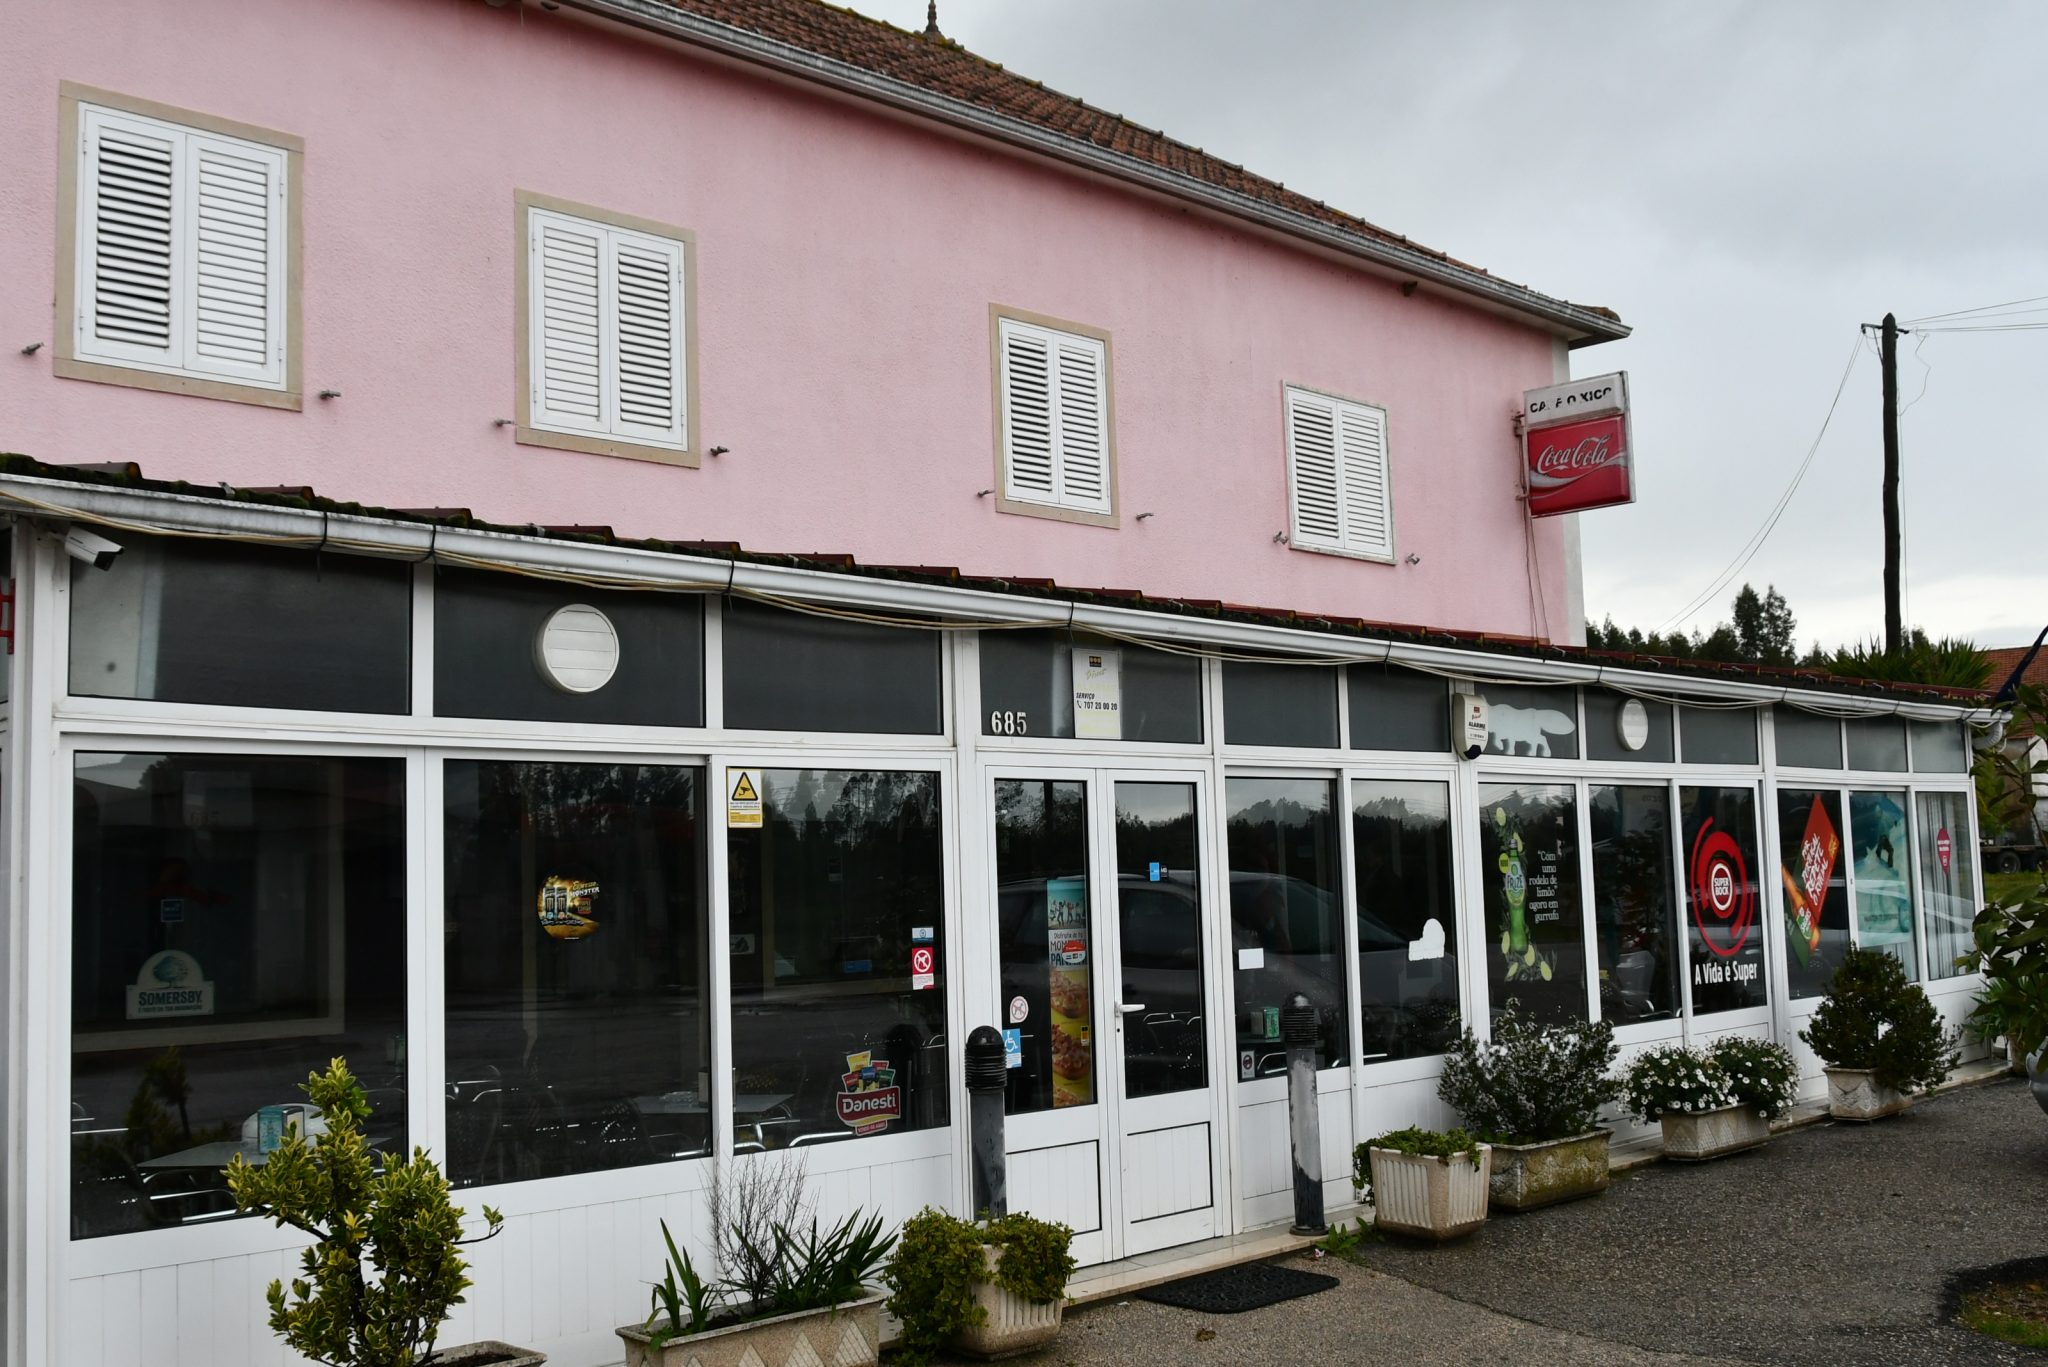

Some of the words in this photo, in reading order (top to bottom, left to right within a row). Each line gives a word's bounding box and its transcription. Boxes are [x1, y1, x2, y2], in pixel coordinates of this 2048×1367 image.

[1537, 435, 1611, 474] Coca-Cola
[1075, 692, 1095, 700] SERVIÇO
[1084, 701, 1094, 710] 707
[1095, 702, 1102, 710] 20
[1103, 702, 1110, 711] 00
[1111, 702, 1118, 711] 20
[991, 711, 1027, 735] 685
[1469, 721, 1486, 729] ALARME
[1542, 865, 1557, 873] uma
[1529, 874, 1549, 886] rodela
[1549, 874, 1558, 885] de
[1713, 877, 1730, 887] SUPER
[1714, 886, 1730, 896] BOCK
[1529, 901, 1548, 912] agora
[1548, 901, 1559, 909] em
[1535, 909, 1560, 924] garrafa
[1695, 963, 1702, 985] A
[1703, 961, 1723, 984] Vida
[1725, 960, 1731, 982] é
[1732, 960, 1758, 986] Super
[138, 990, 203, 1006] SOMERSBY
[841, 1092, 897, 1114] Danesti
